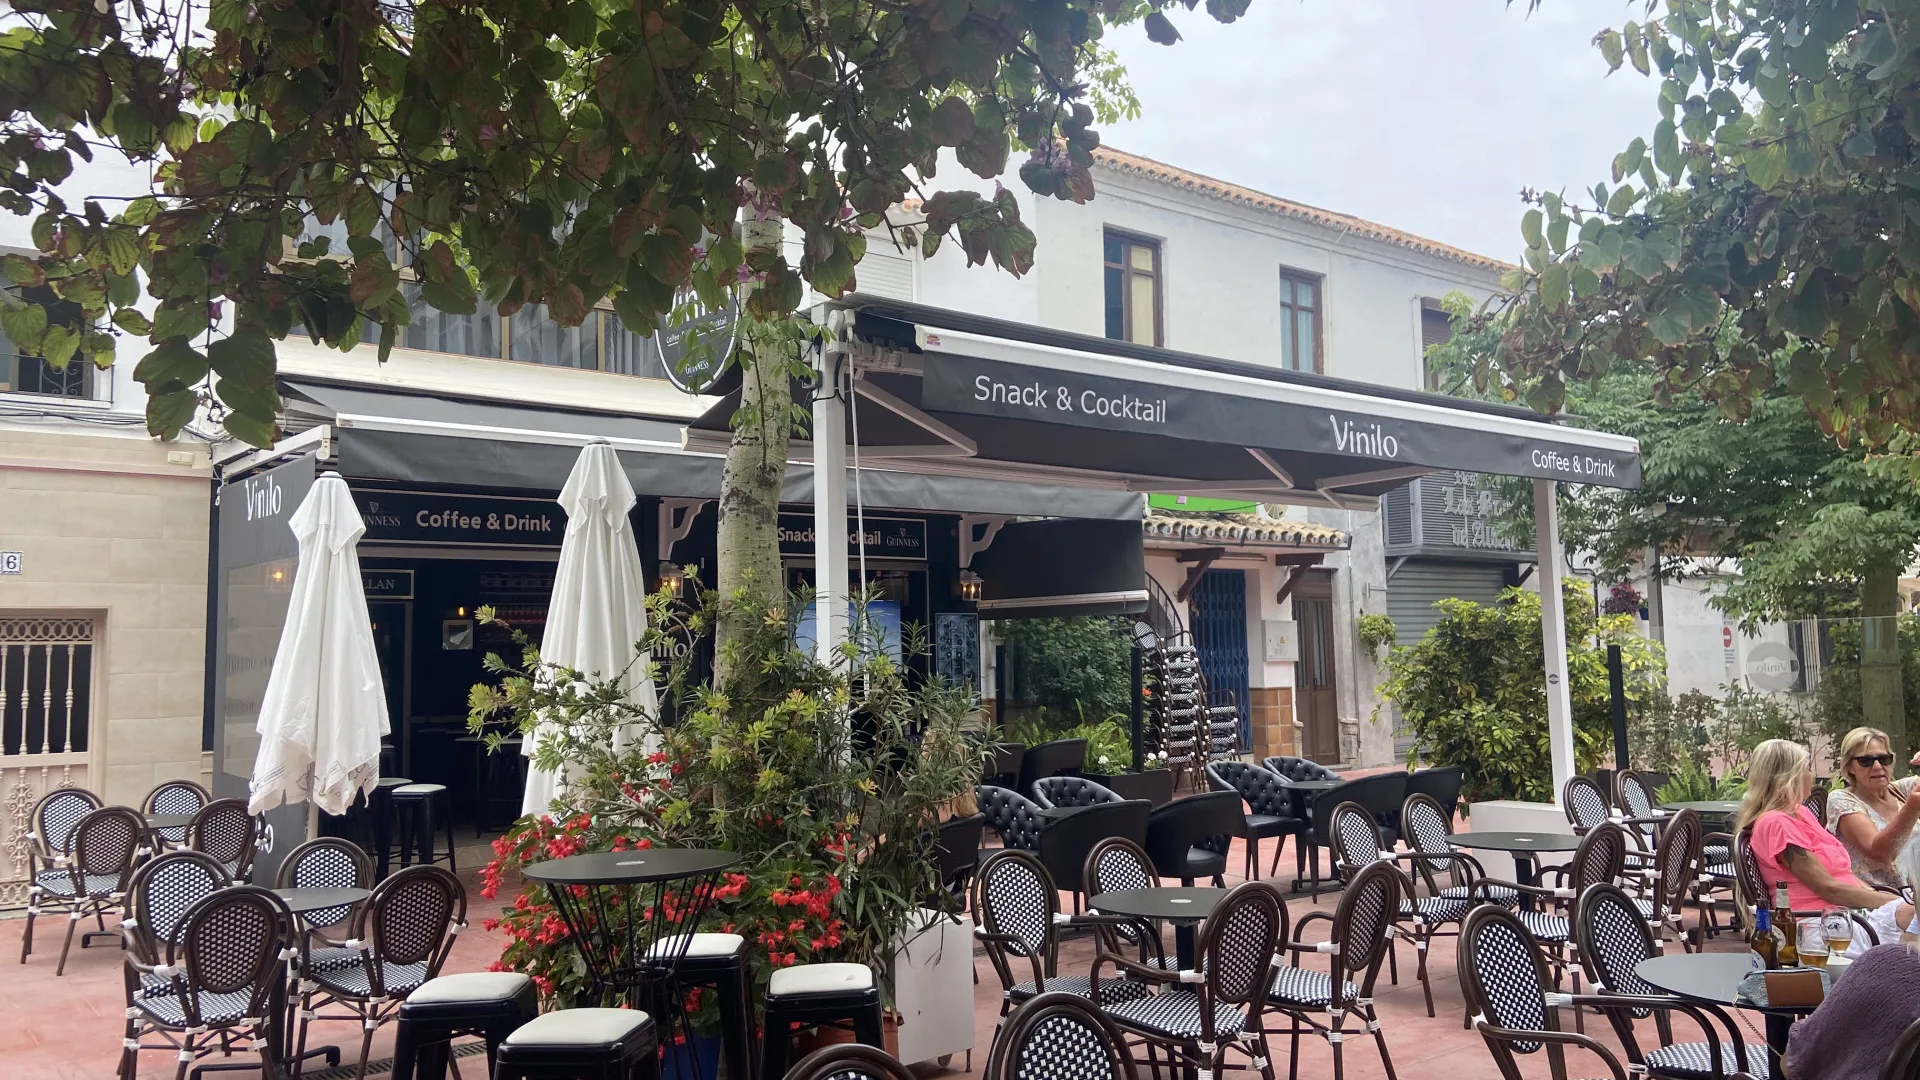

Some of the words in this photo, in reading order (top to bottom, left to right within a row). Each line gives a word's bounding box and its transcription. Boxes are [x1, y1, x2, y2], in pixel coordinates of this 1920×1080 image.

[974, 375, 1048, 409] Snack
[1056, 386, 1073, 412] &
[1080, 390, 1167, 423] Cocktail
[1329, 414, 1398, 458] Vinilo
[1531, 449, 1570, 472] Coffee
[1572, 455, 1582, 474] &
[1585, 456, 1615, 478] Drink
[244, 474, 282, 522] Vinilo
[416, 509, 481, 529] Coffee
[486, 512, 500, 530] &
[504, 513, 552, 532] Drink
[778, 527, 815, 542] Snack
[6, 555, 17, 570] 6
